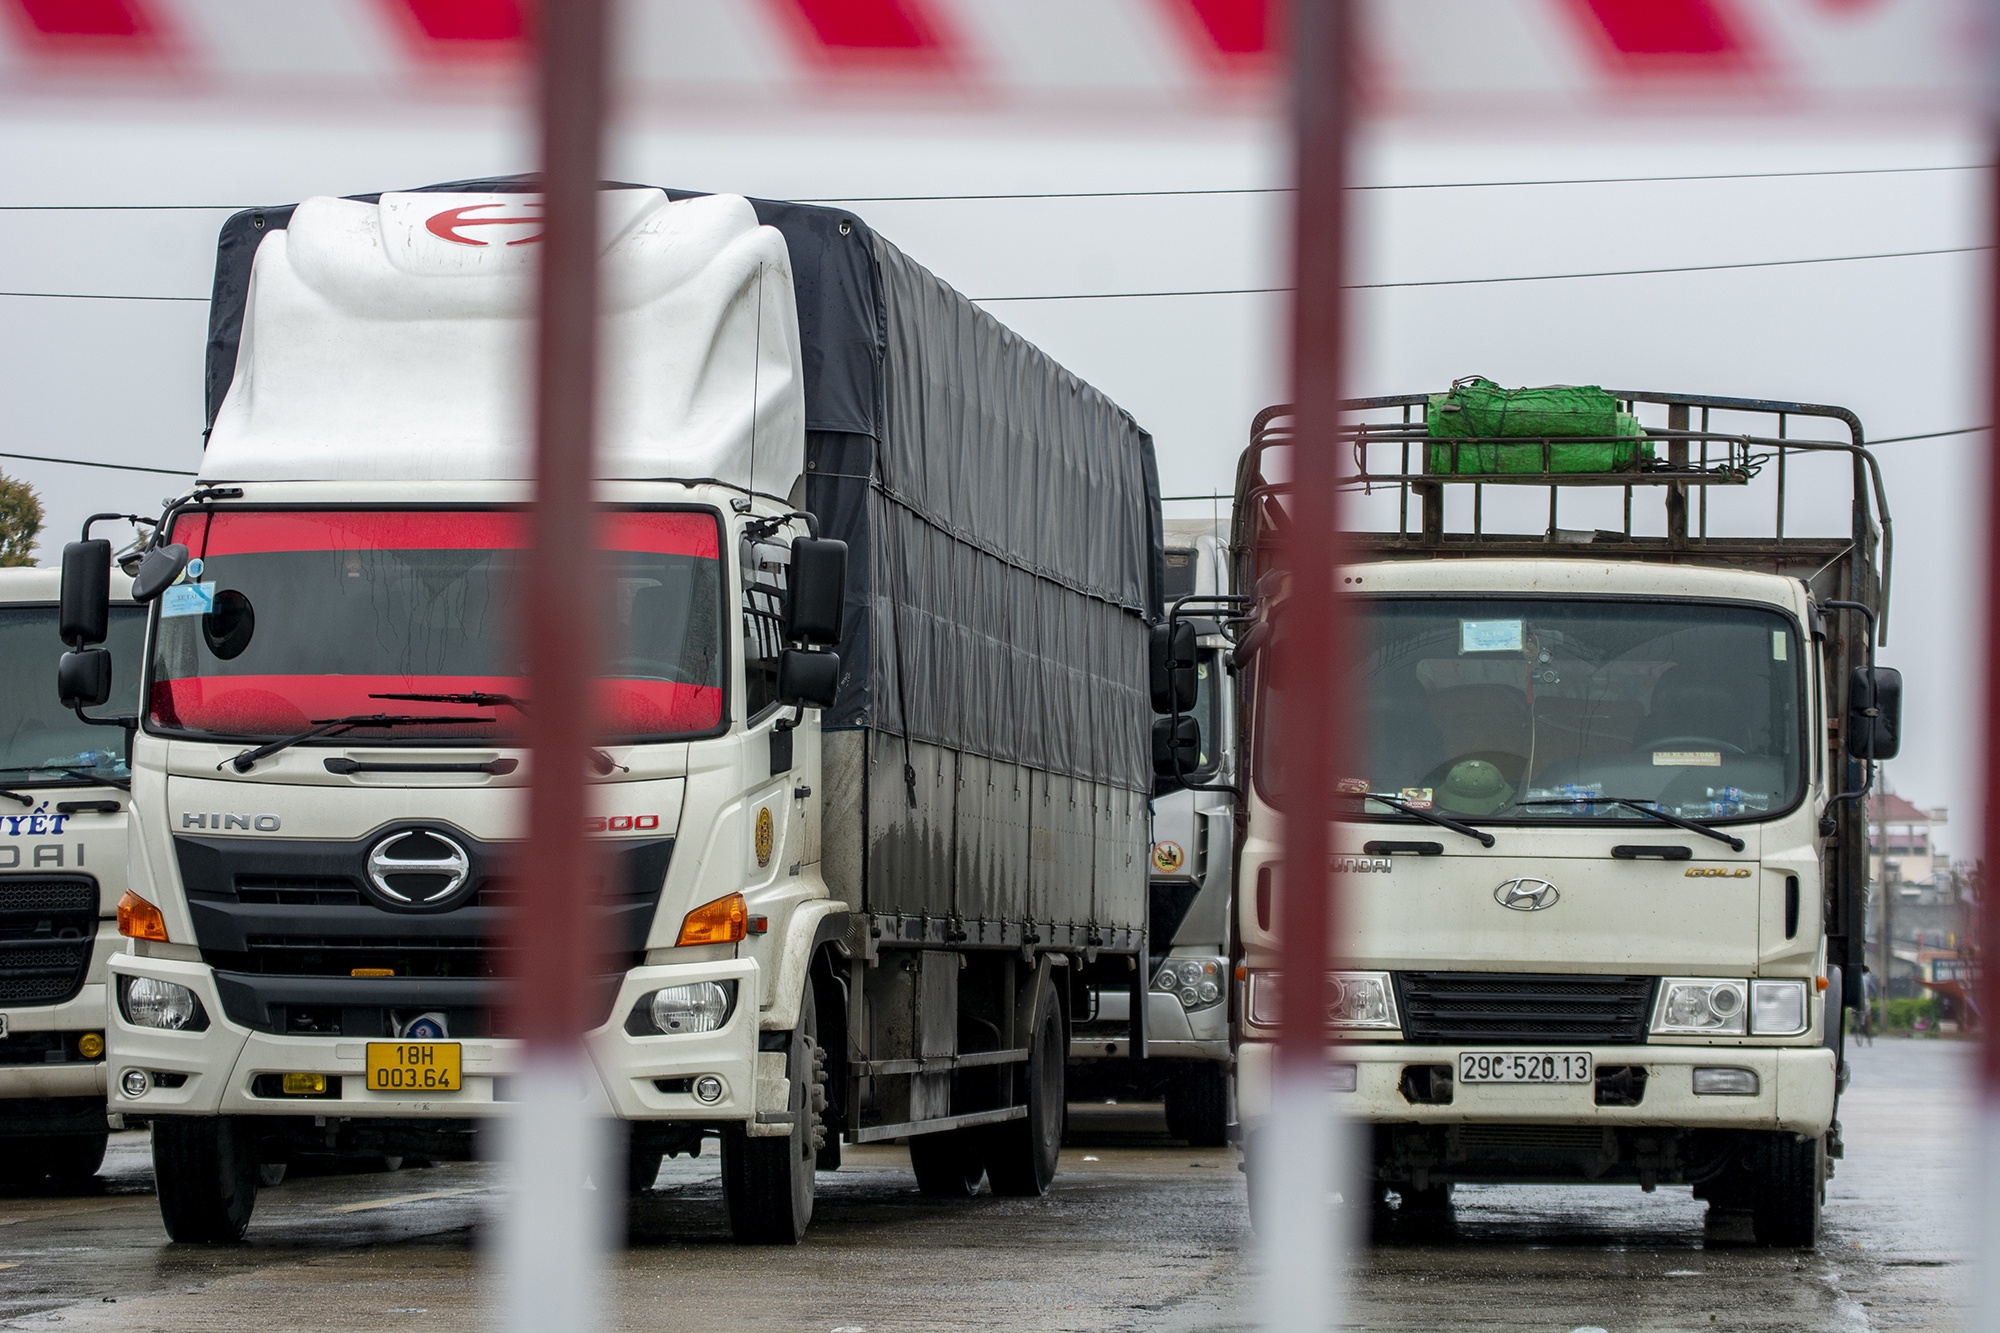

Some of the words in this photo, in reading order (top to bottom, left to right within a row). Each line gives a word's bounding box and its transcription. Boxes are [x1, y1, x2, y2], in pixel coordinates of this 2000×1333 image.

[0, 801, 70, 836] YẾT
[182, 811, 281, 832] HINO
[1330, 858, 1392, 873] UNDAI
[1684, 867, 1752, 878] GOLD
[397, 1046, 434, 1065] 18H
[377, 1068, 450, 1088] 003.64
